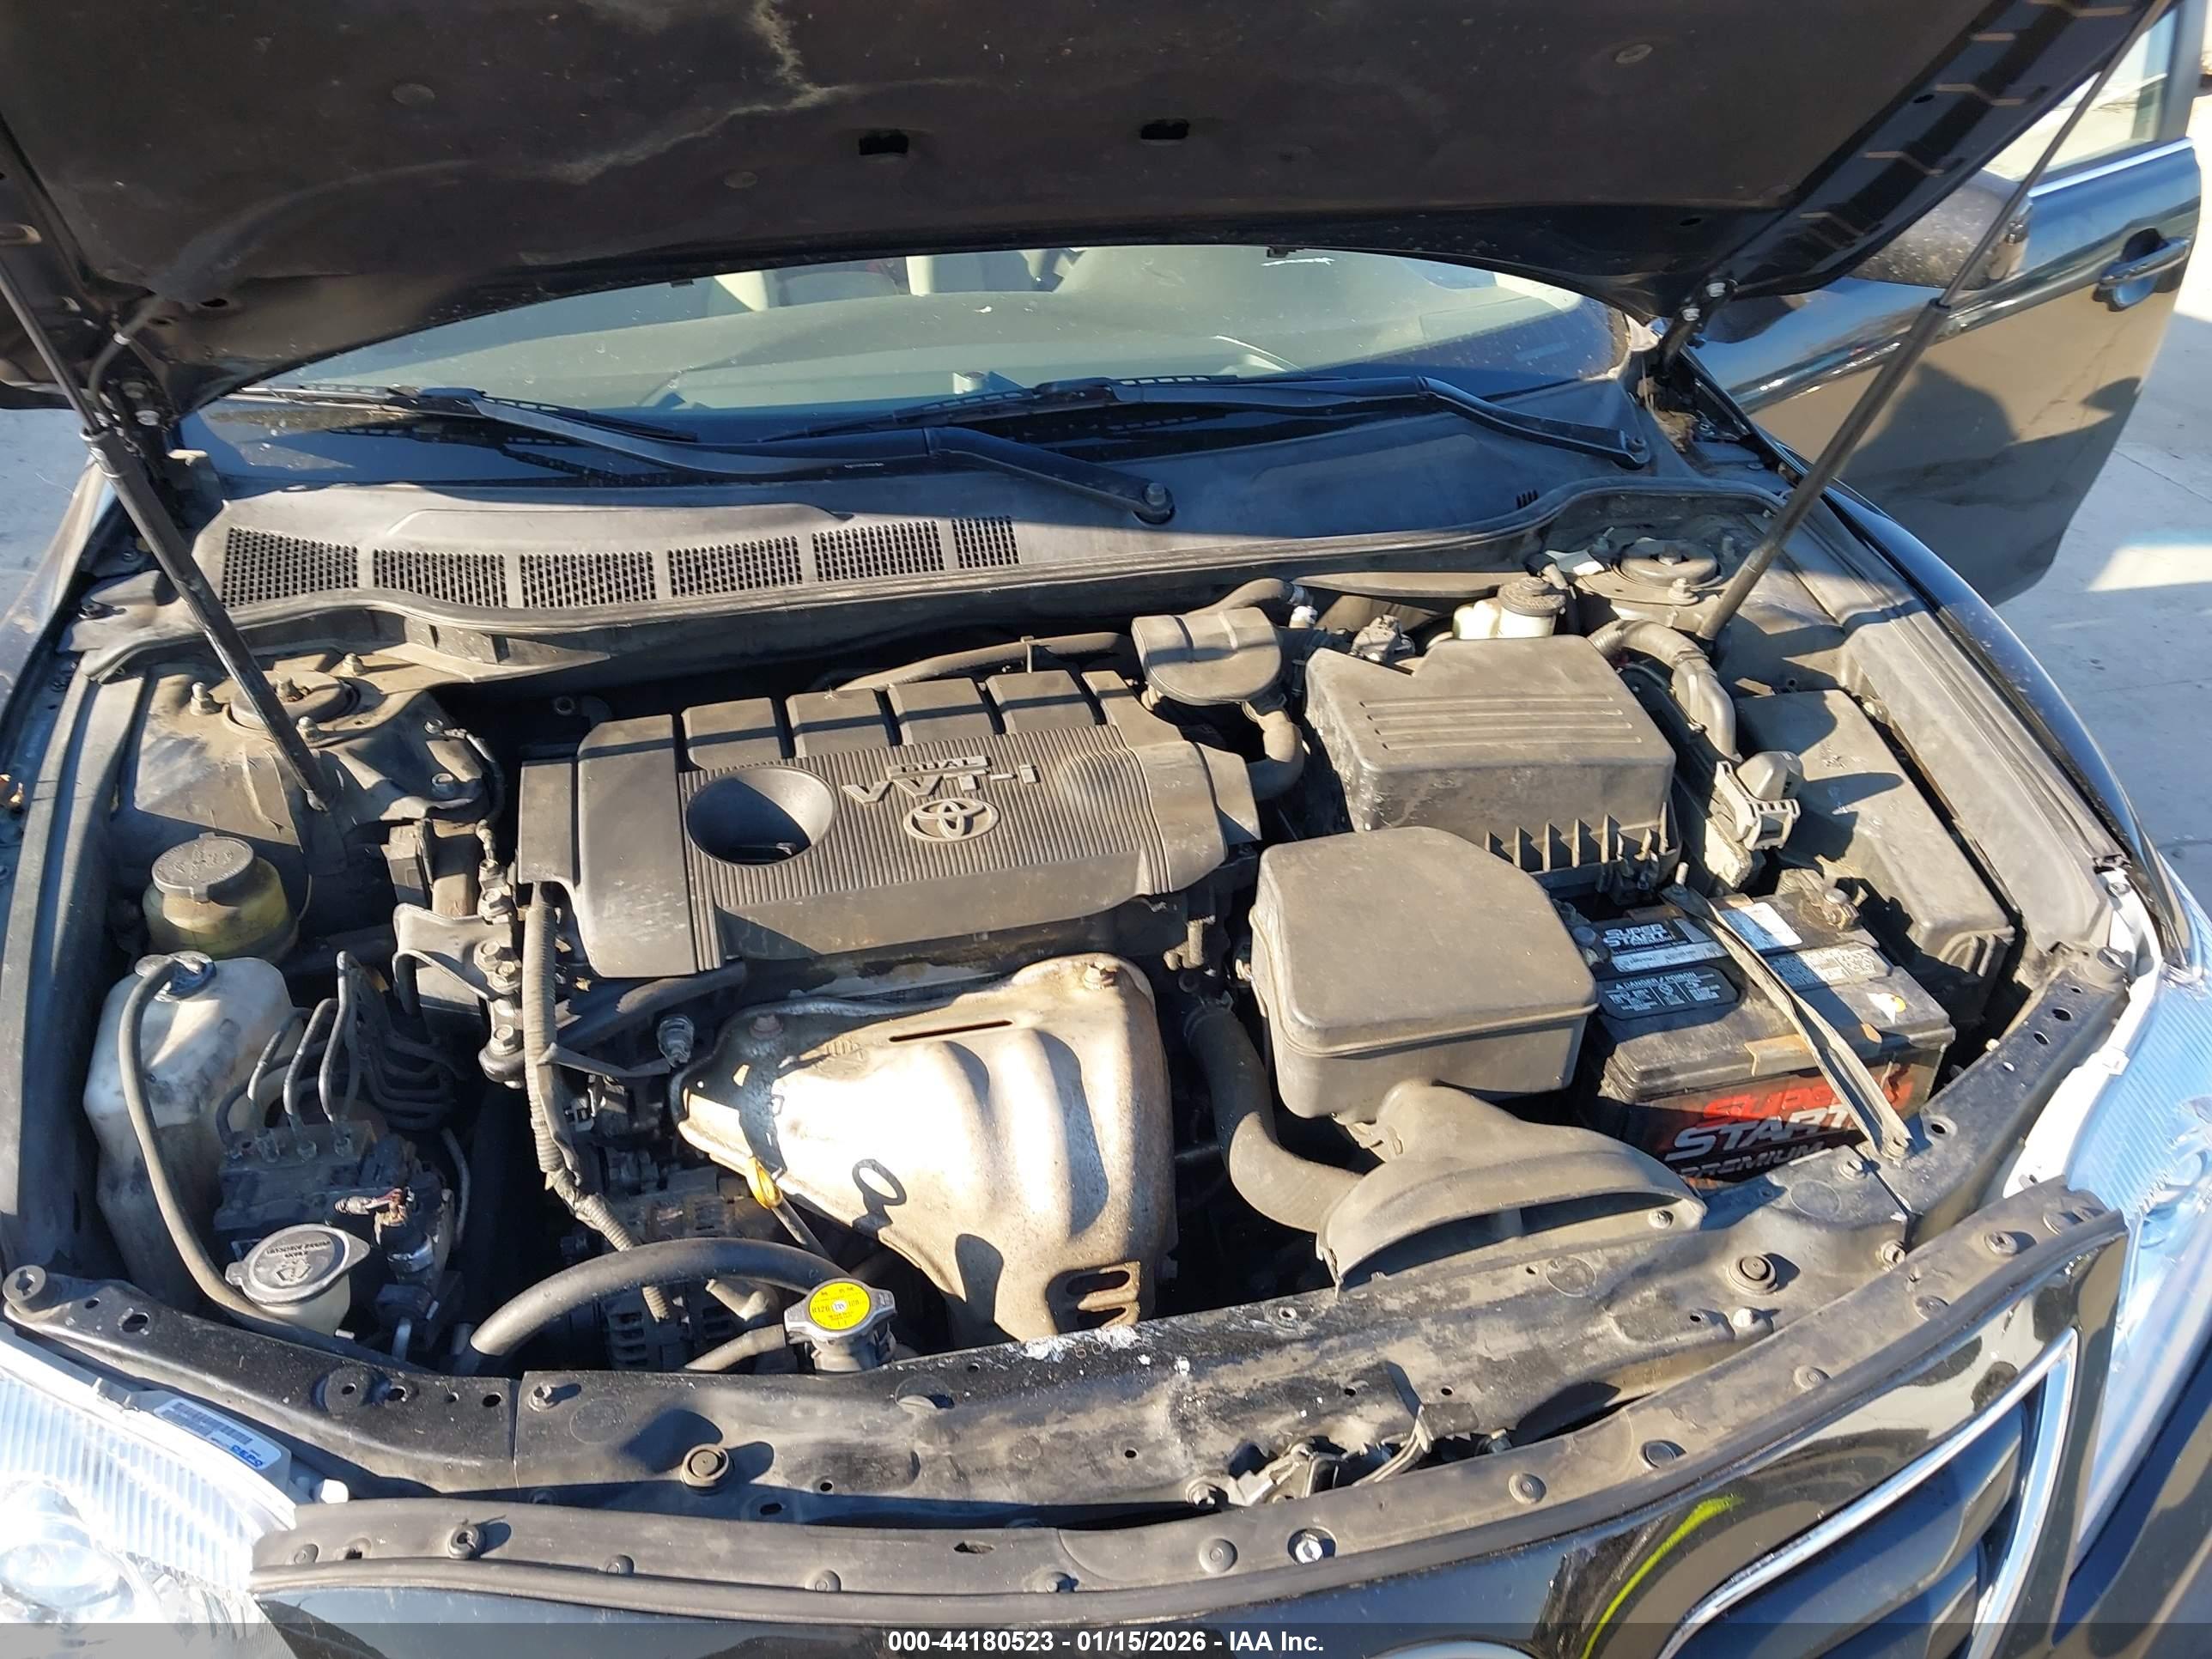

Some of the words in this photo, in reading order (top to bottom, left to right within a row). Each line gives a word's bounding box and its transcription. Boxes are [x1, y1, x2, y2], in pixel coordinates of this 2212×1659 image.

[896, 757, 983, 774] DUAL
[1605, 924, 1668, 937] SUPER
[1603, 932, 1664, 947] START
[1665, 1103, 1848, 1162] START
[1680, 1140, 1826, 1176] PREMIUM
